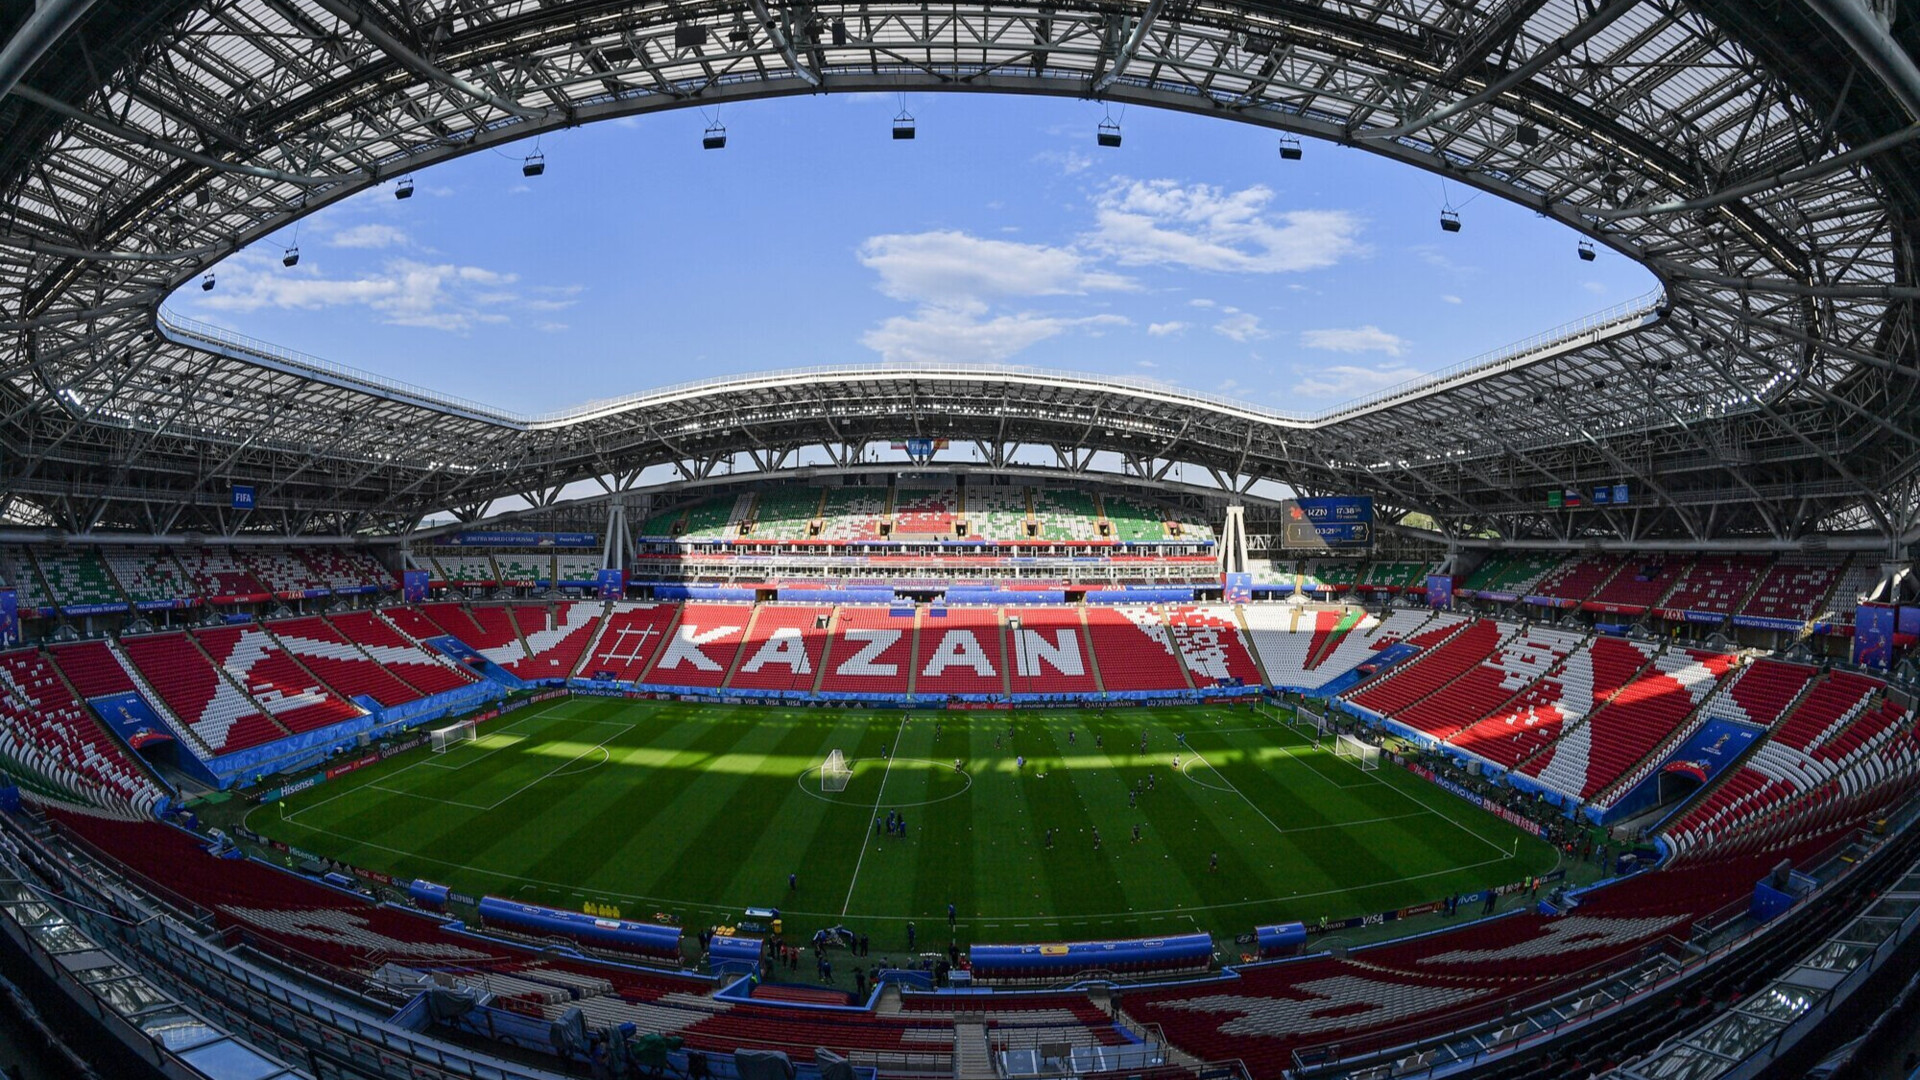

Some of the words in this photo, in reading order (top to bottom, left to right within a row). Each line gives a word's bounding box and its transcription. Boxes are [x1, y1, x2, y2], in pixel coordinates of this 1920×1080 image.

[235, 493, 252, 503] FIFA
[588, 689, 605, 697] vivo
[605, 690, 623, 698] vivo
[1084, 701, 1107, 709] QATAR
[1107, 700, 1136, 708] AIRWAYS
[1172, 698, 1199, 706] WANDA
[381, 746, 399, 759] QATAR
[399, 740, 419, 752] AIRWAYS
[280, 777, 315, 797] Hisense
[1435, 775, 1450, 789] vivo
[1450, 783, 1466, 797] vivo
[1466, 791, 1483, 806] vivo
[288, 846, 320, 864] Hisense
[1458, 893, 1479, 906] vivo
[1407, 905, 1433, 914] McDonald's
[1362, 913, 1384, 926] VISA
